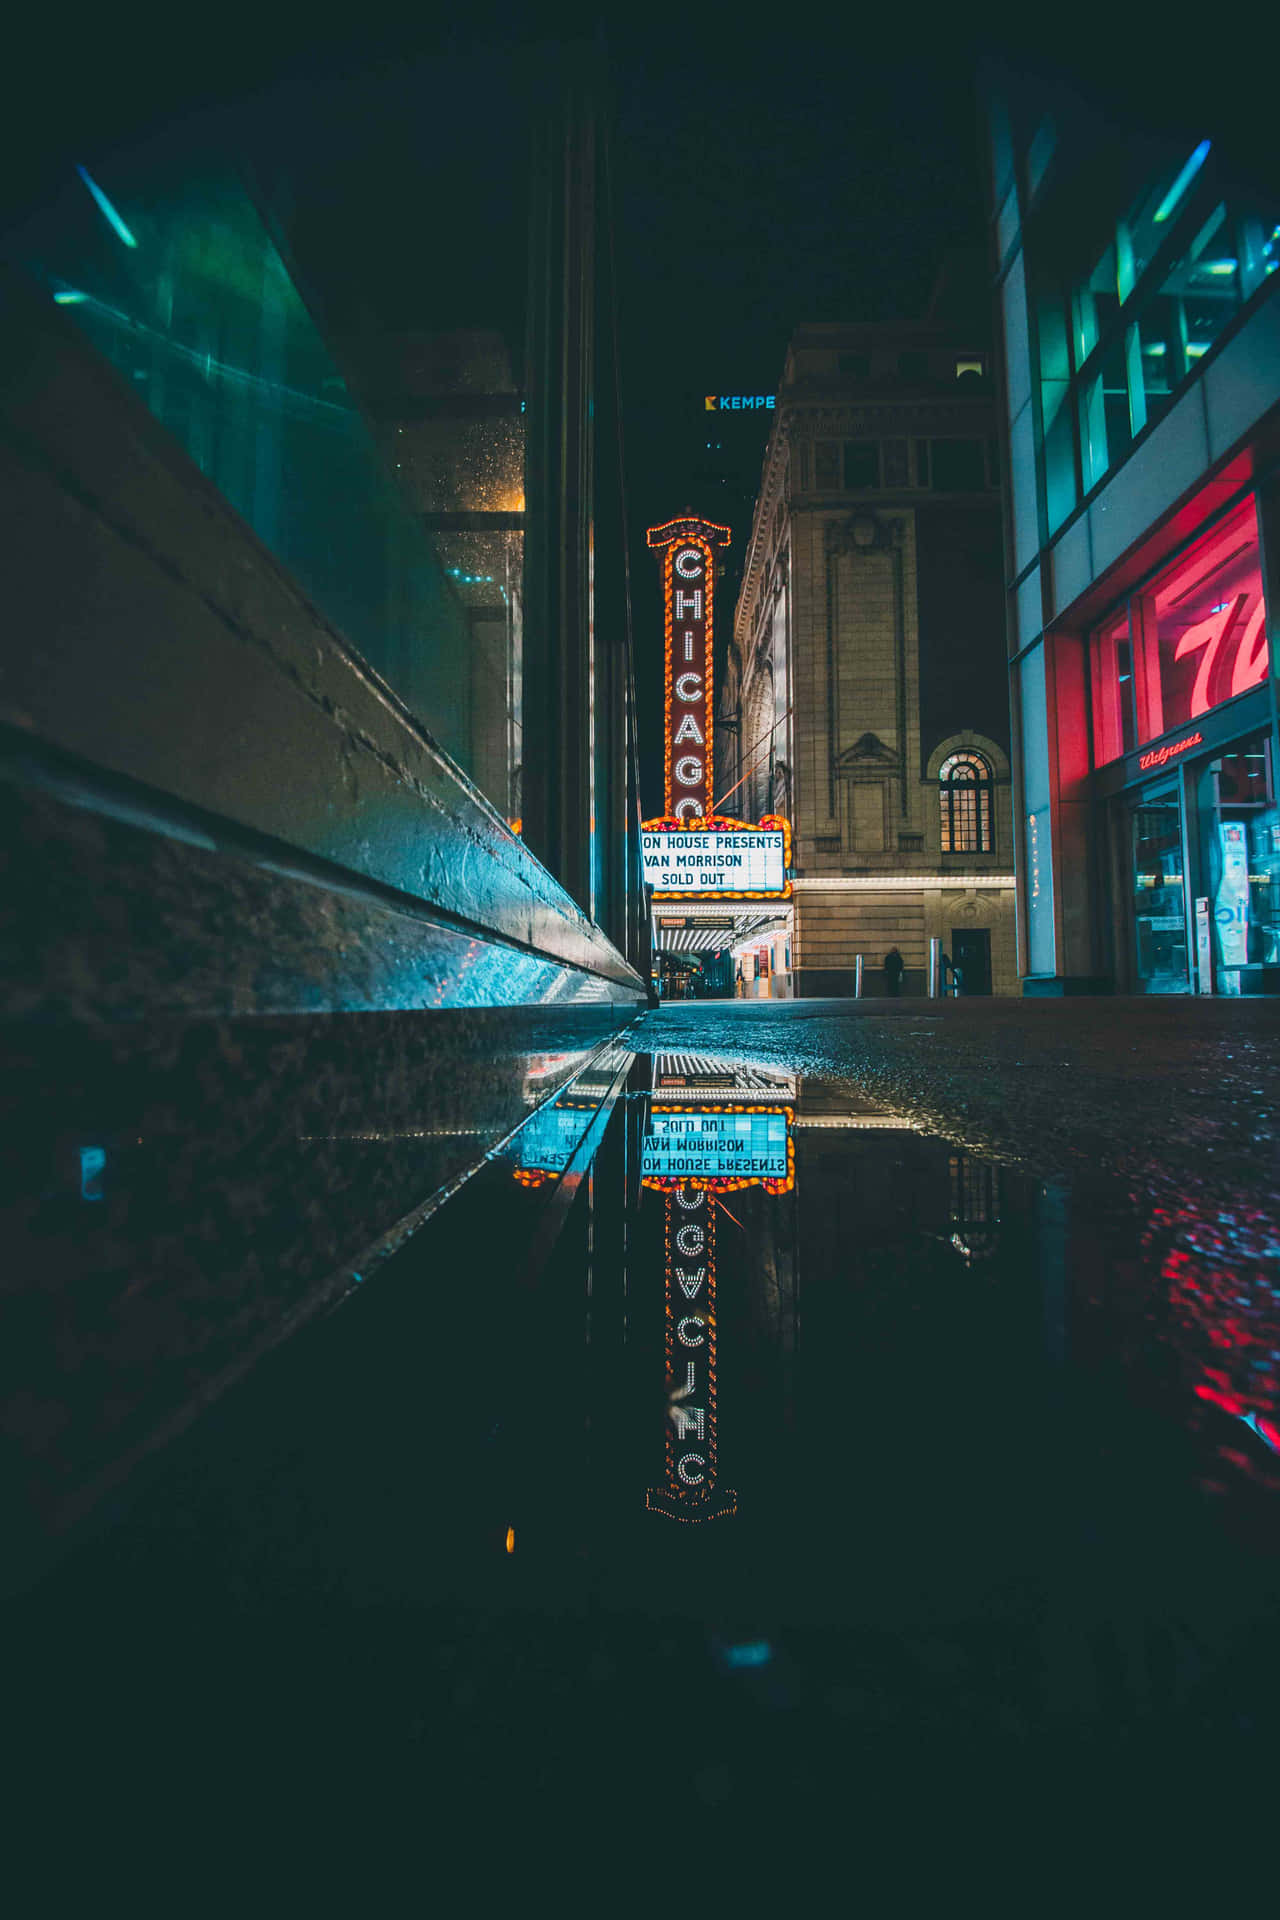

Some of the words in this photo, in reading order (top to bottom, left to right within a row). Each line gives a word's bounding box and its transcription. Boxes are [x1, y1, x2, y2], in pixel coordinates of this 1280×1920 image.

[675, 549, 703, 819] CHICAGO
[1139, 732, 1203, 770] Walgreens
[643, 836, 661, 849] ON
[667, 836, 710, 849] HOUSE
[716, 836, 782, 849] PRESENTS
[644, 855, 669, 867] VAN
[676, 855, 742, 867] MORRISON
[661, 873, 694, 885] SOLD
[700, 873, 725, 885] OUT
